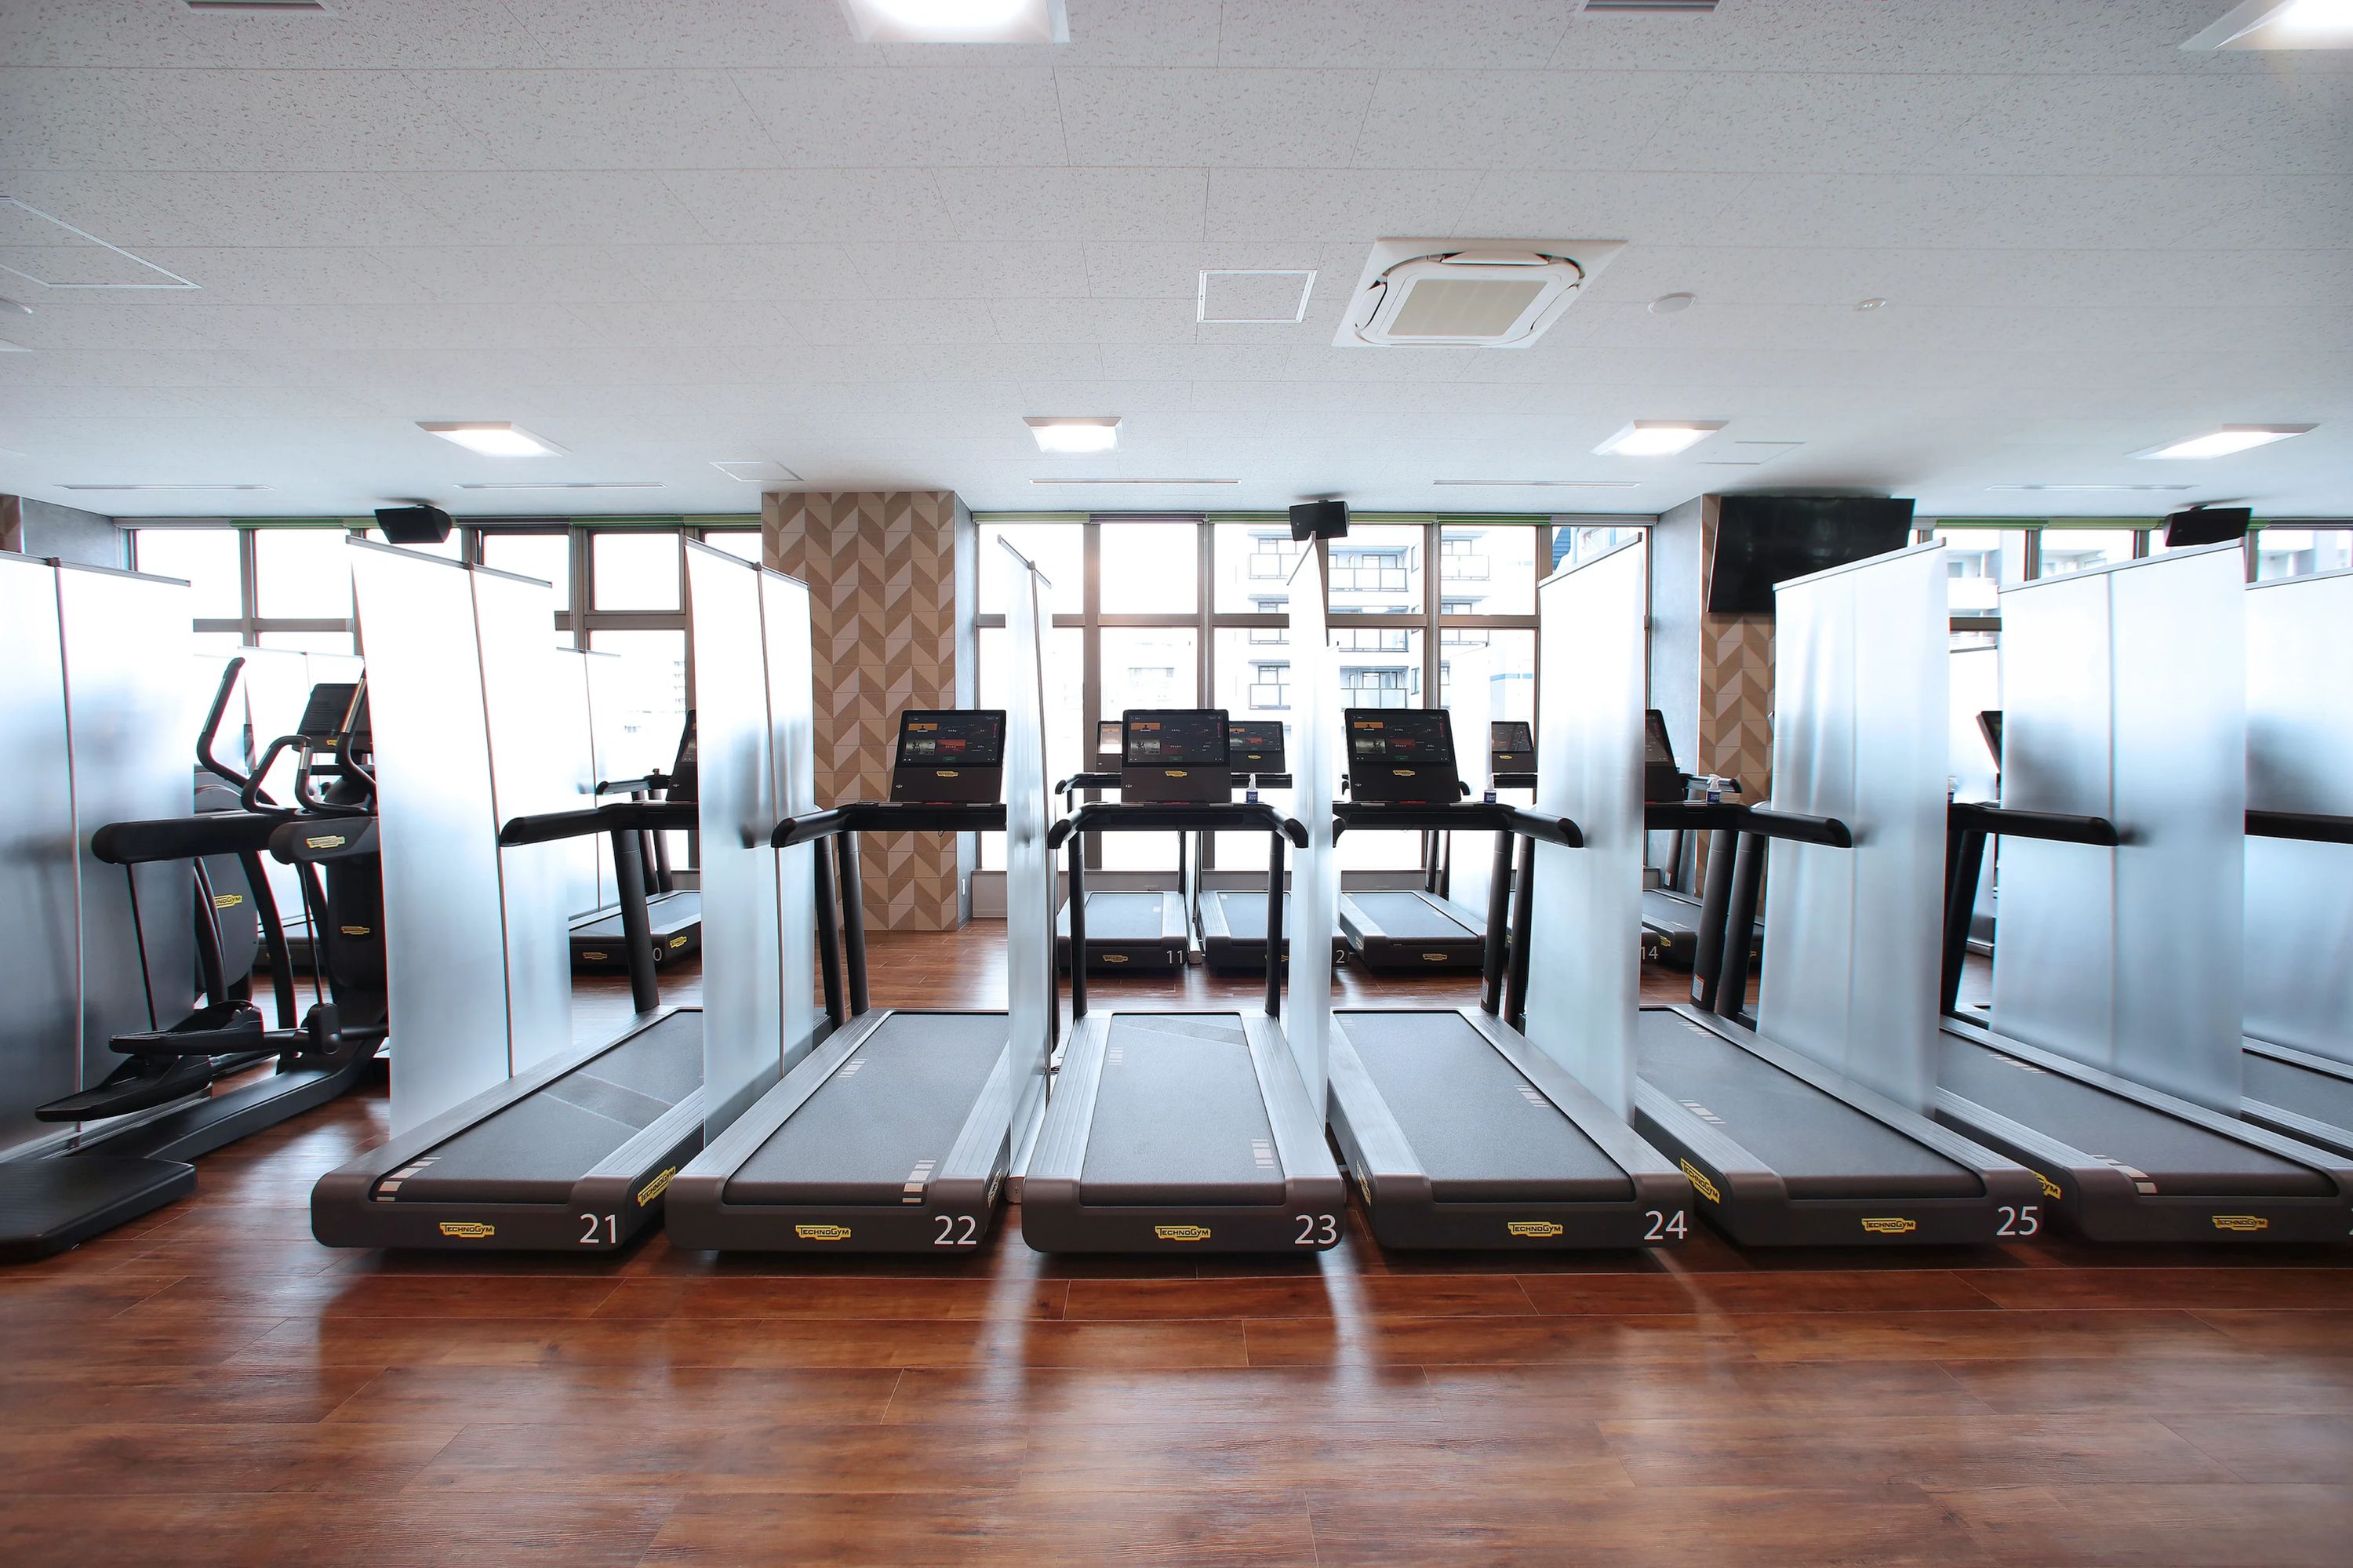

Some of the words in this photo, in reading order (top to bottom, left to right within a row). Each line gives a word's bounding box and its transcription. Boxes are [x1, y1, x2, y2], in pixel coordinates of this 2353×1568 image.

[1166, 950, 1183, 964] 11
[1641, 946, 1659, 960] 14
[1644, 1210, 1687, 1240] 24
[1863, 1219, 1915, 1231] TECHNOGYM
[1996, 1206, 2038, 1235] 25
[441, 1224, 493, 1235] TECHNOGYM
[580, 1213, 616, 1243] 21
[797, 1226, 850, 1238] TECHNOGYM
[934, 1215, 976, 1245] 22
[1156, 1226, 1209, 1239] TECHNOGYM
[1295, 1215, 1337, 1244] 23
[1509, 1223, 1562, 1235] TECHNOGYM
